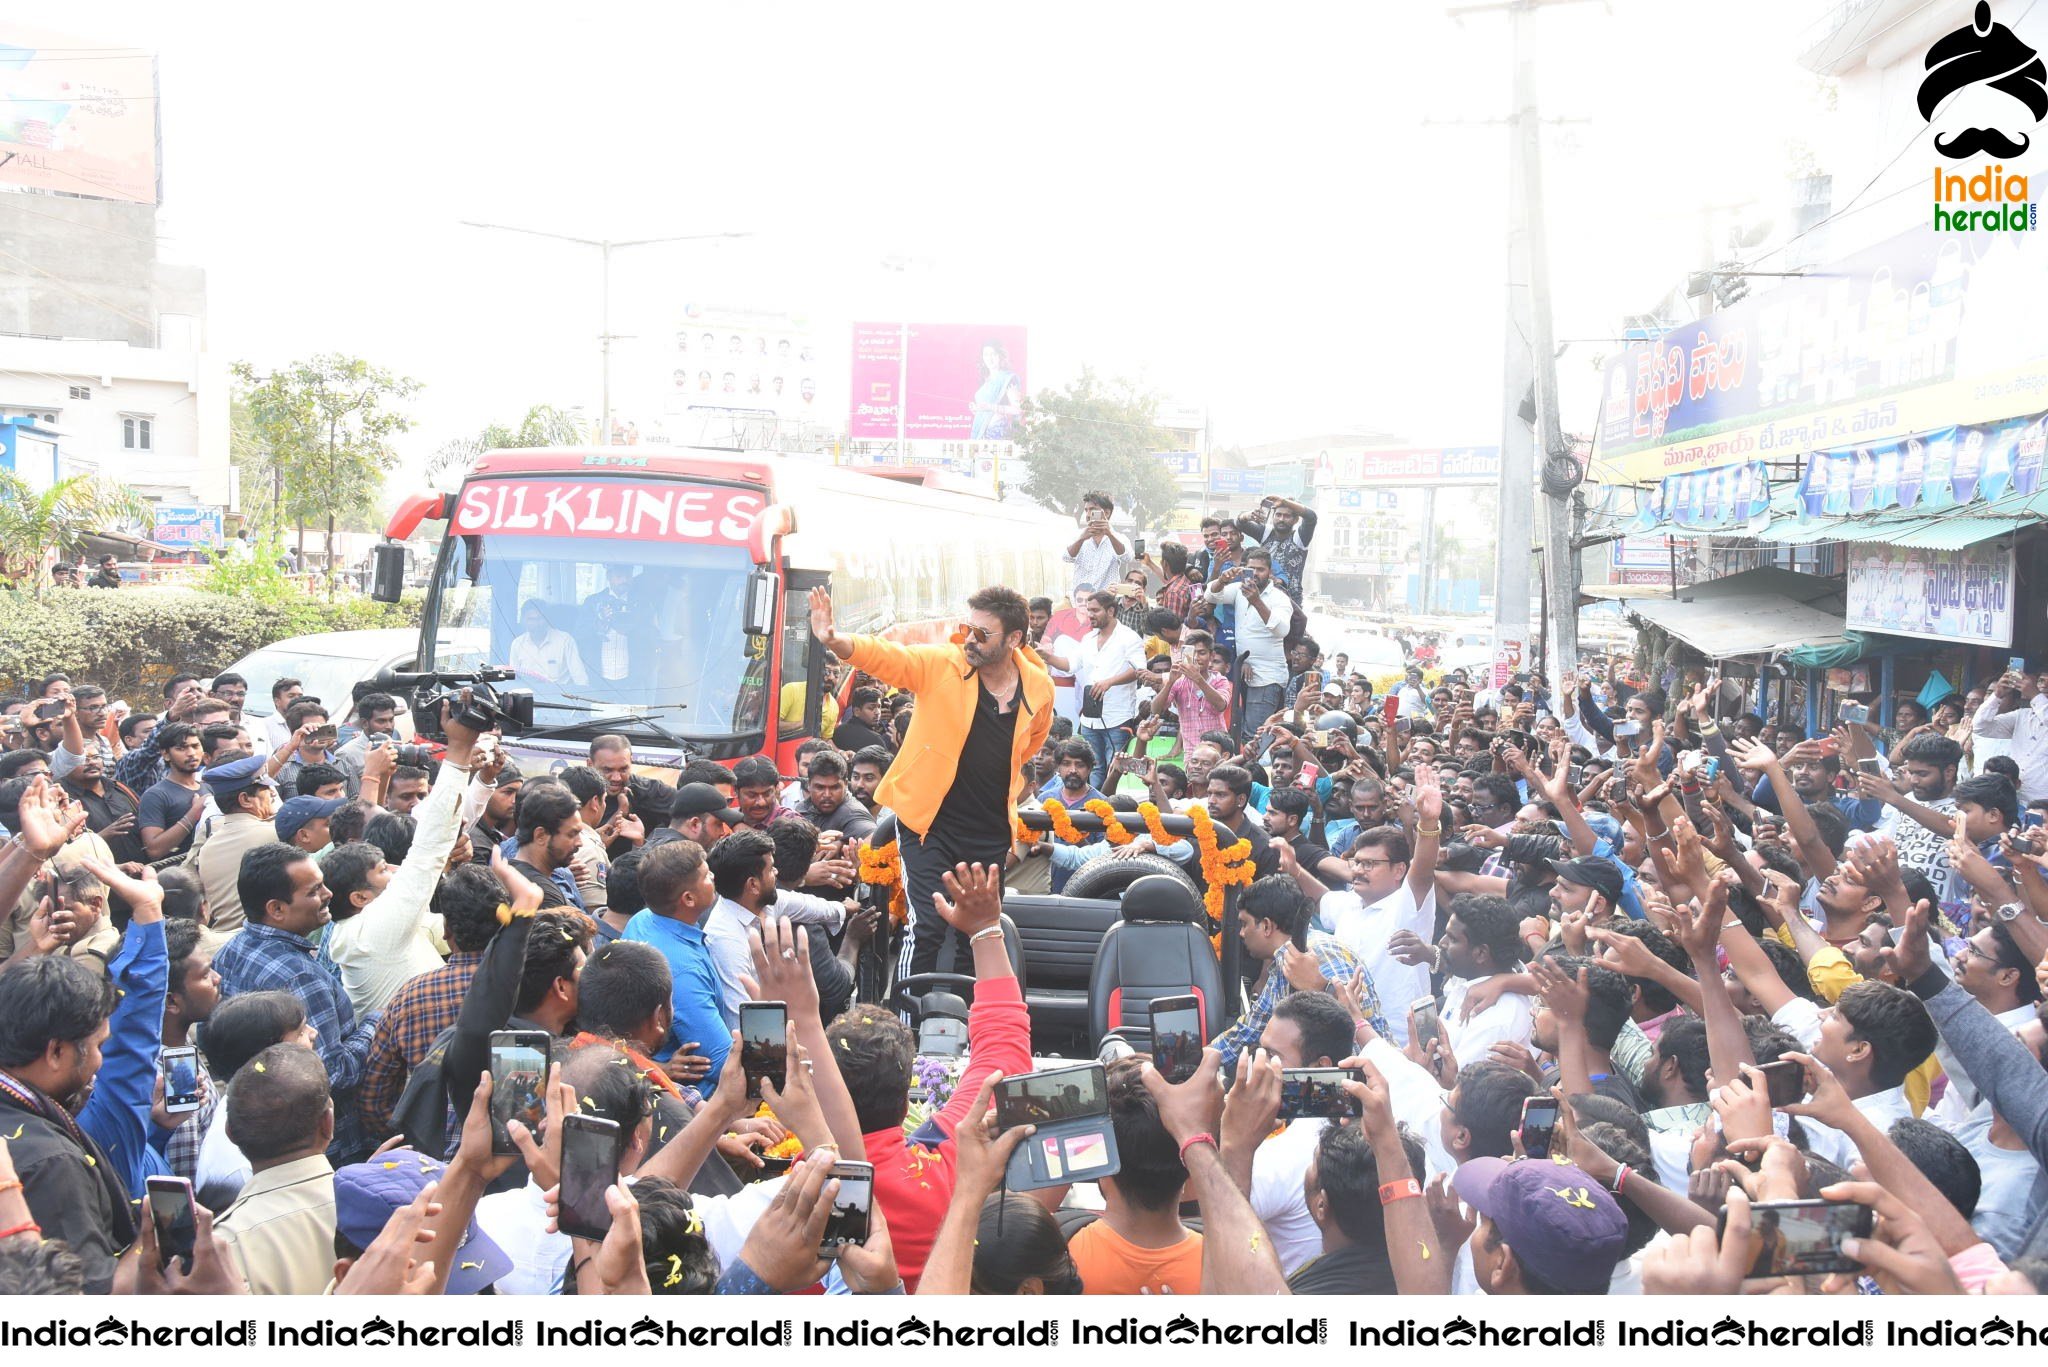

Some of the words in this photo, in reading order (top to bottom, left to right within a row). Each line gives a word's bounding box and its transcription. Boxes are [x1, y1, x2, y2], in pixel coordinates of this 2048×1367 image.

[1689, 328, 1747, 401] పాలు
[1831, 412, 1850, 436] &
[457, 484, 762, 541] SILKLINES
